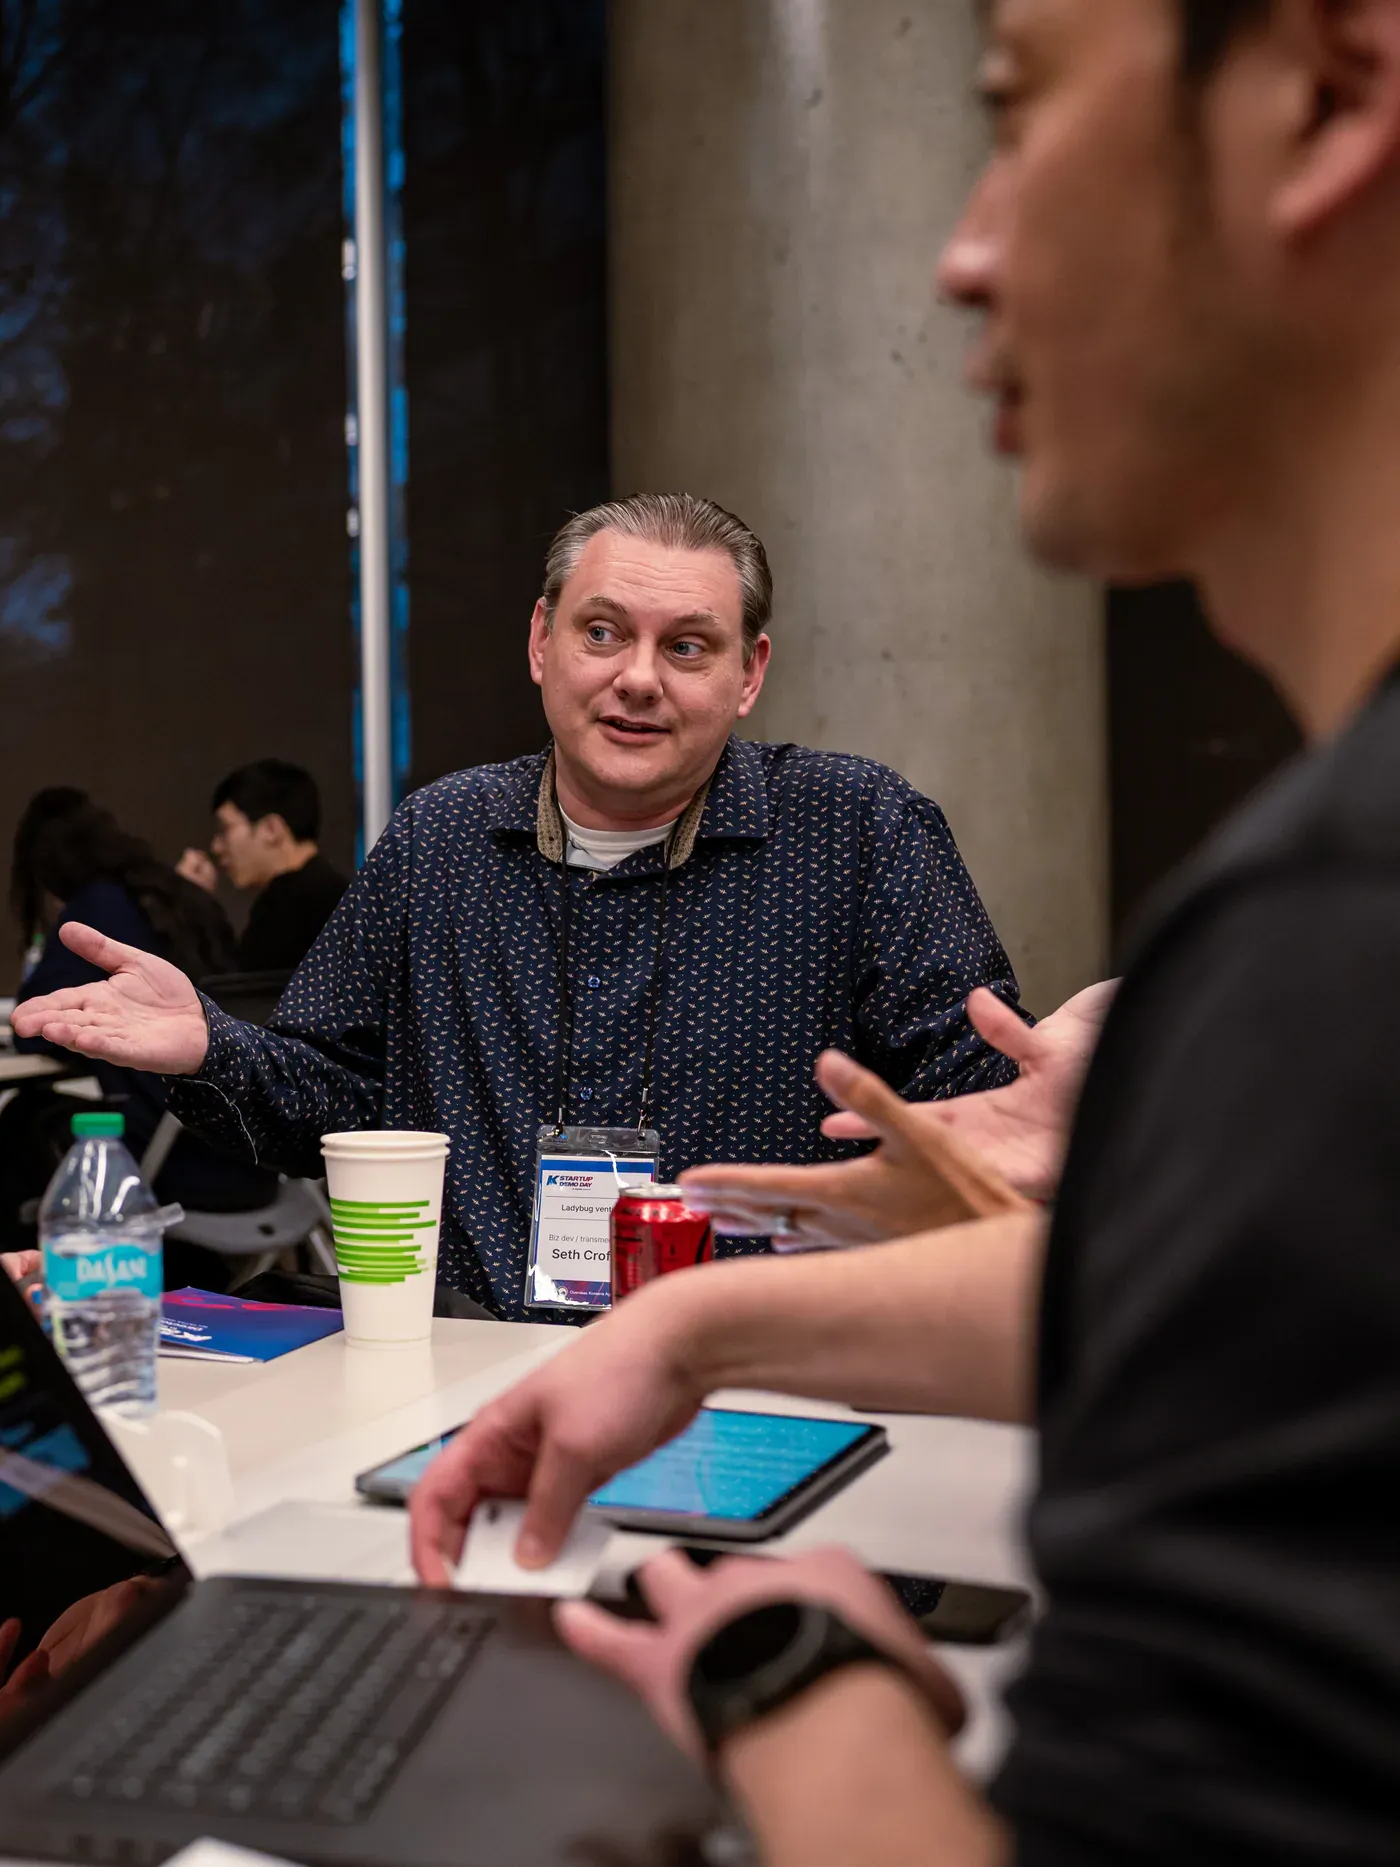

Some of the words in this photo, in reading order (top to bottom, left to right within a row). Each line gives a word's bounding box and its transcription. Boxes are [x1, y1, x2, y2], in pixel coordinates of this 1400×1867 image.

[546, 1175, 559, 1186] K
[561, 1204, 594, 1213] Ladybug
[580, 1235, 610, 1243] transme
[552, 1248, 580, 1260] Seth
